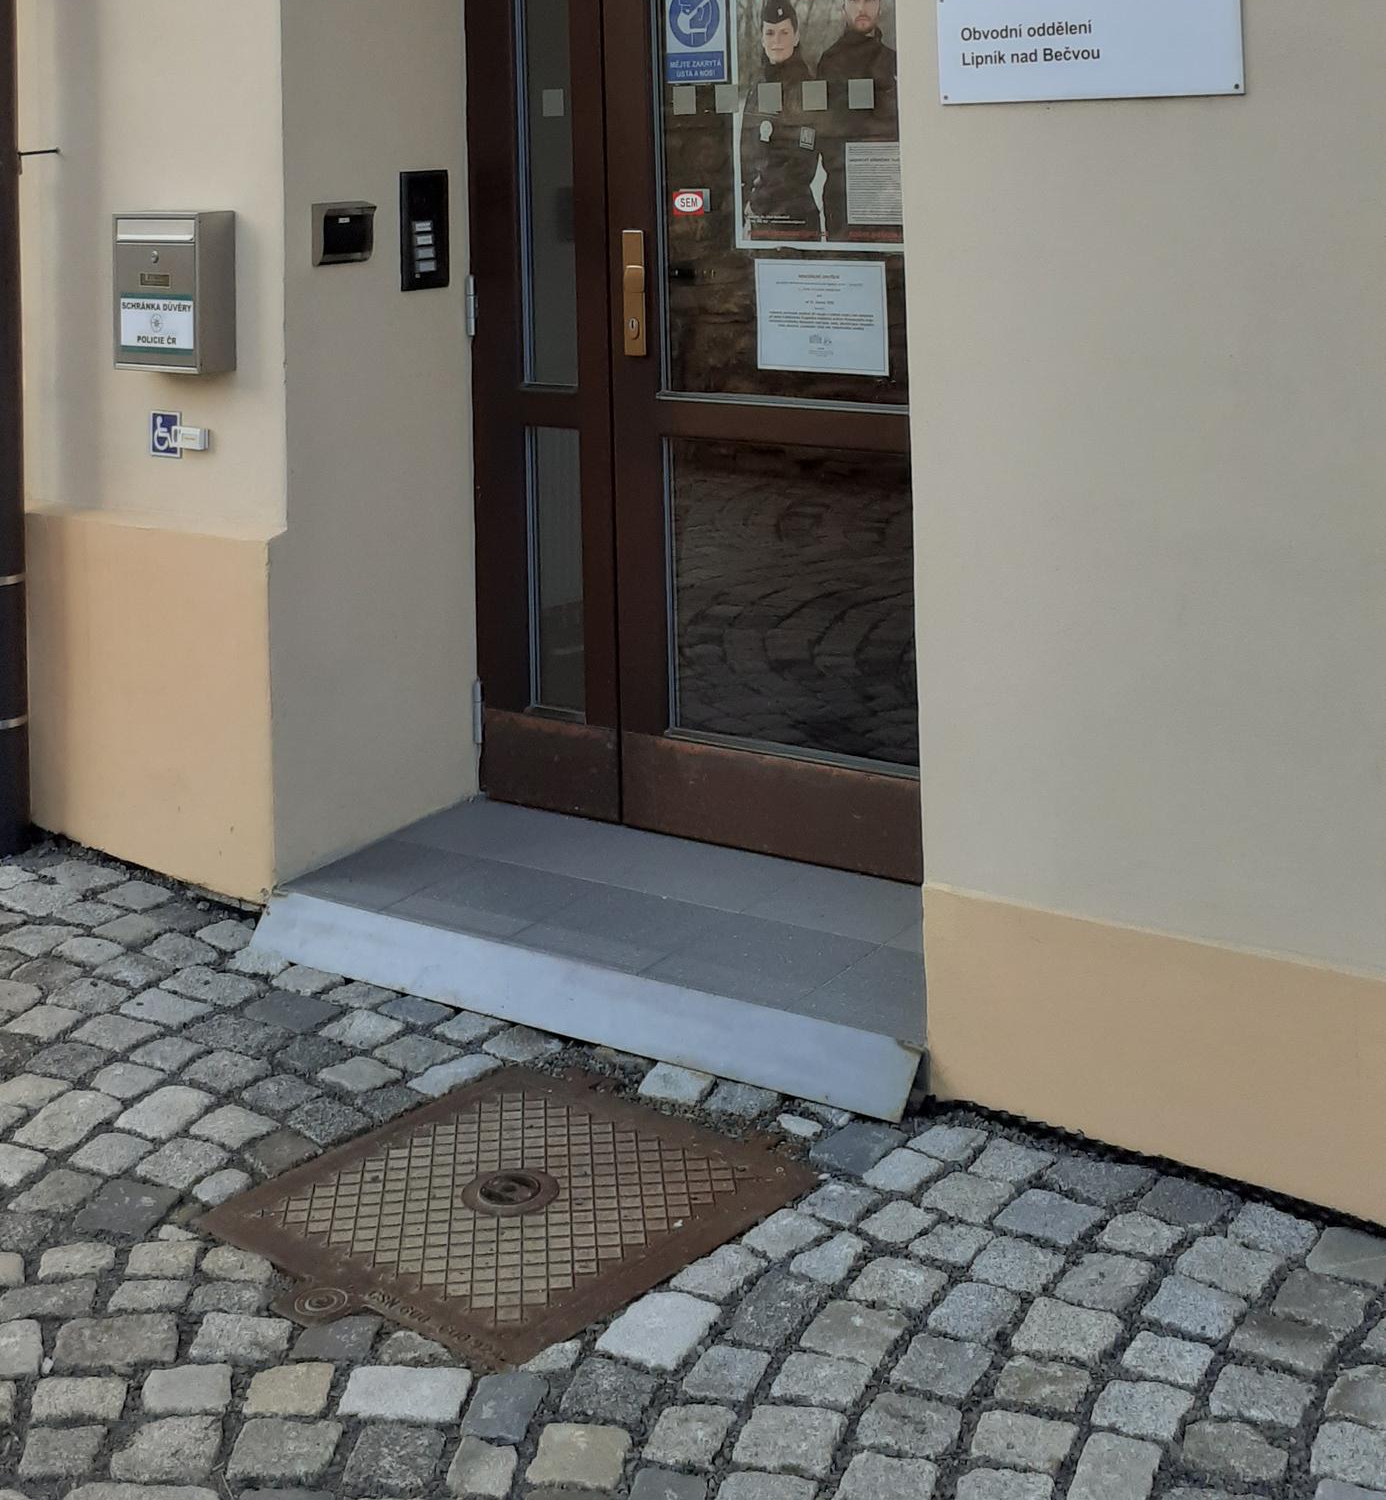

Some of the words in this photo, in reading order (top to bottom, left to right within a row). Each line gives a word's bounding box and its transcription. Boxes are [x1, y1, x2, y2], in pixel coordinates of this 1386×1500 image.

[961, 23, 1022, 42] Obvodní
[1027, 19, 1092, 38] oddělení
[961, 50, 1006, 68] Lipník
[1010, 49, 1038, 64] nad
[1043, 46, 1101, 62] Bečvou
[680, 197, 698, 208] SEM
[122, 301, 161, 311] SCHRÁNKA
[136, 335, 165, 345] POLICIE
[166, 334, 177, 345] ČR
